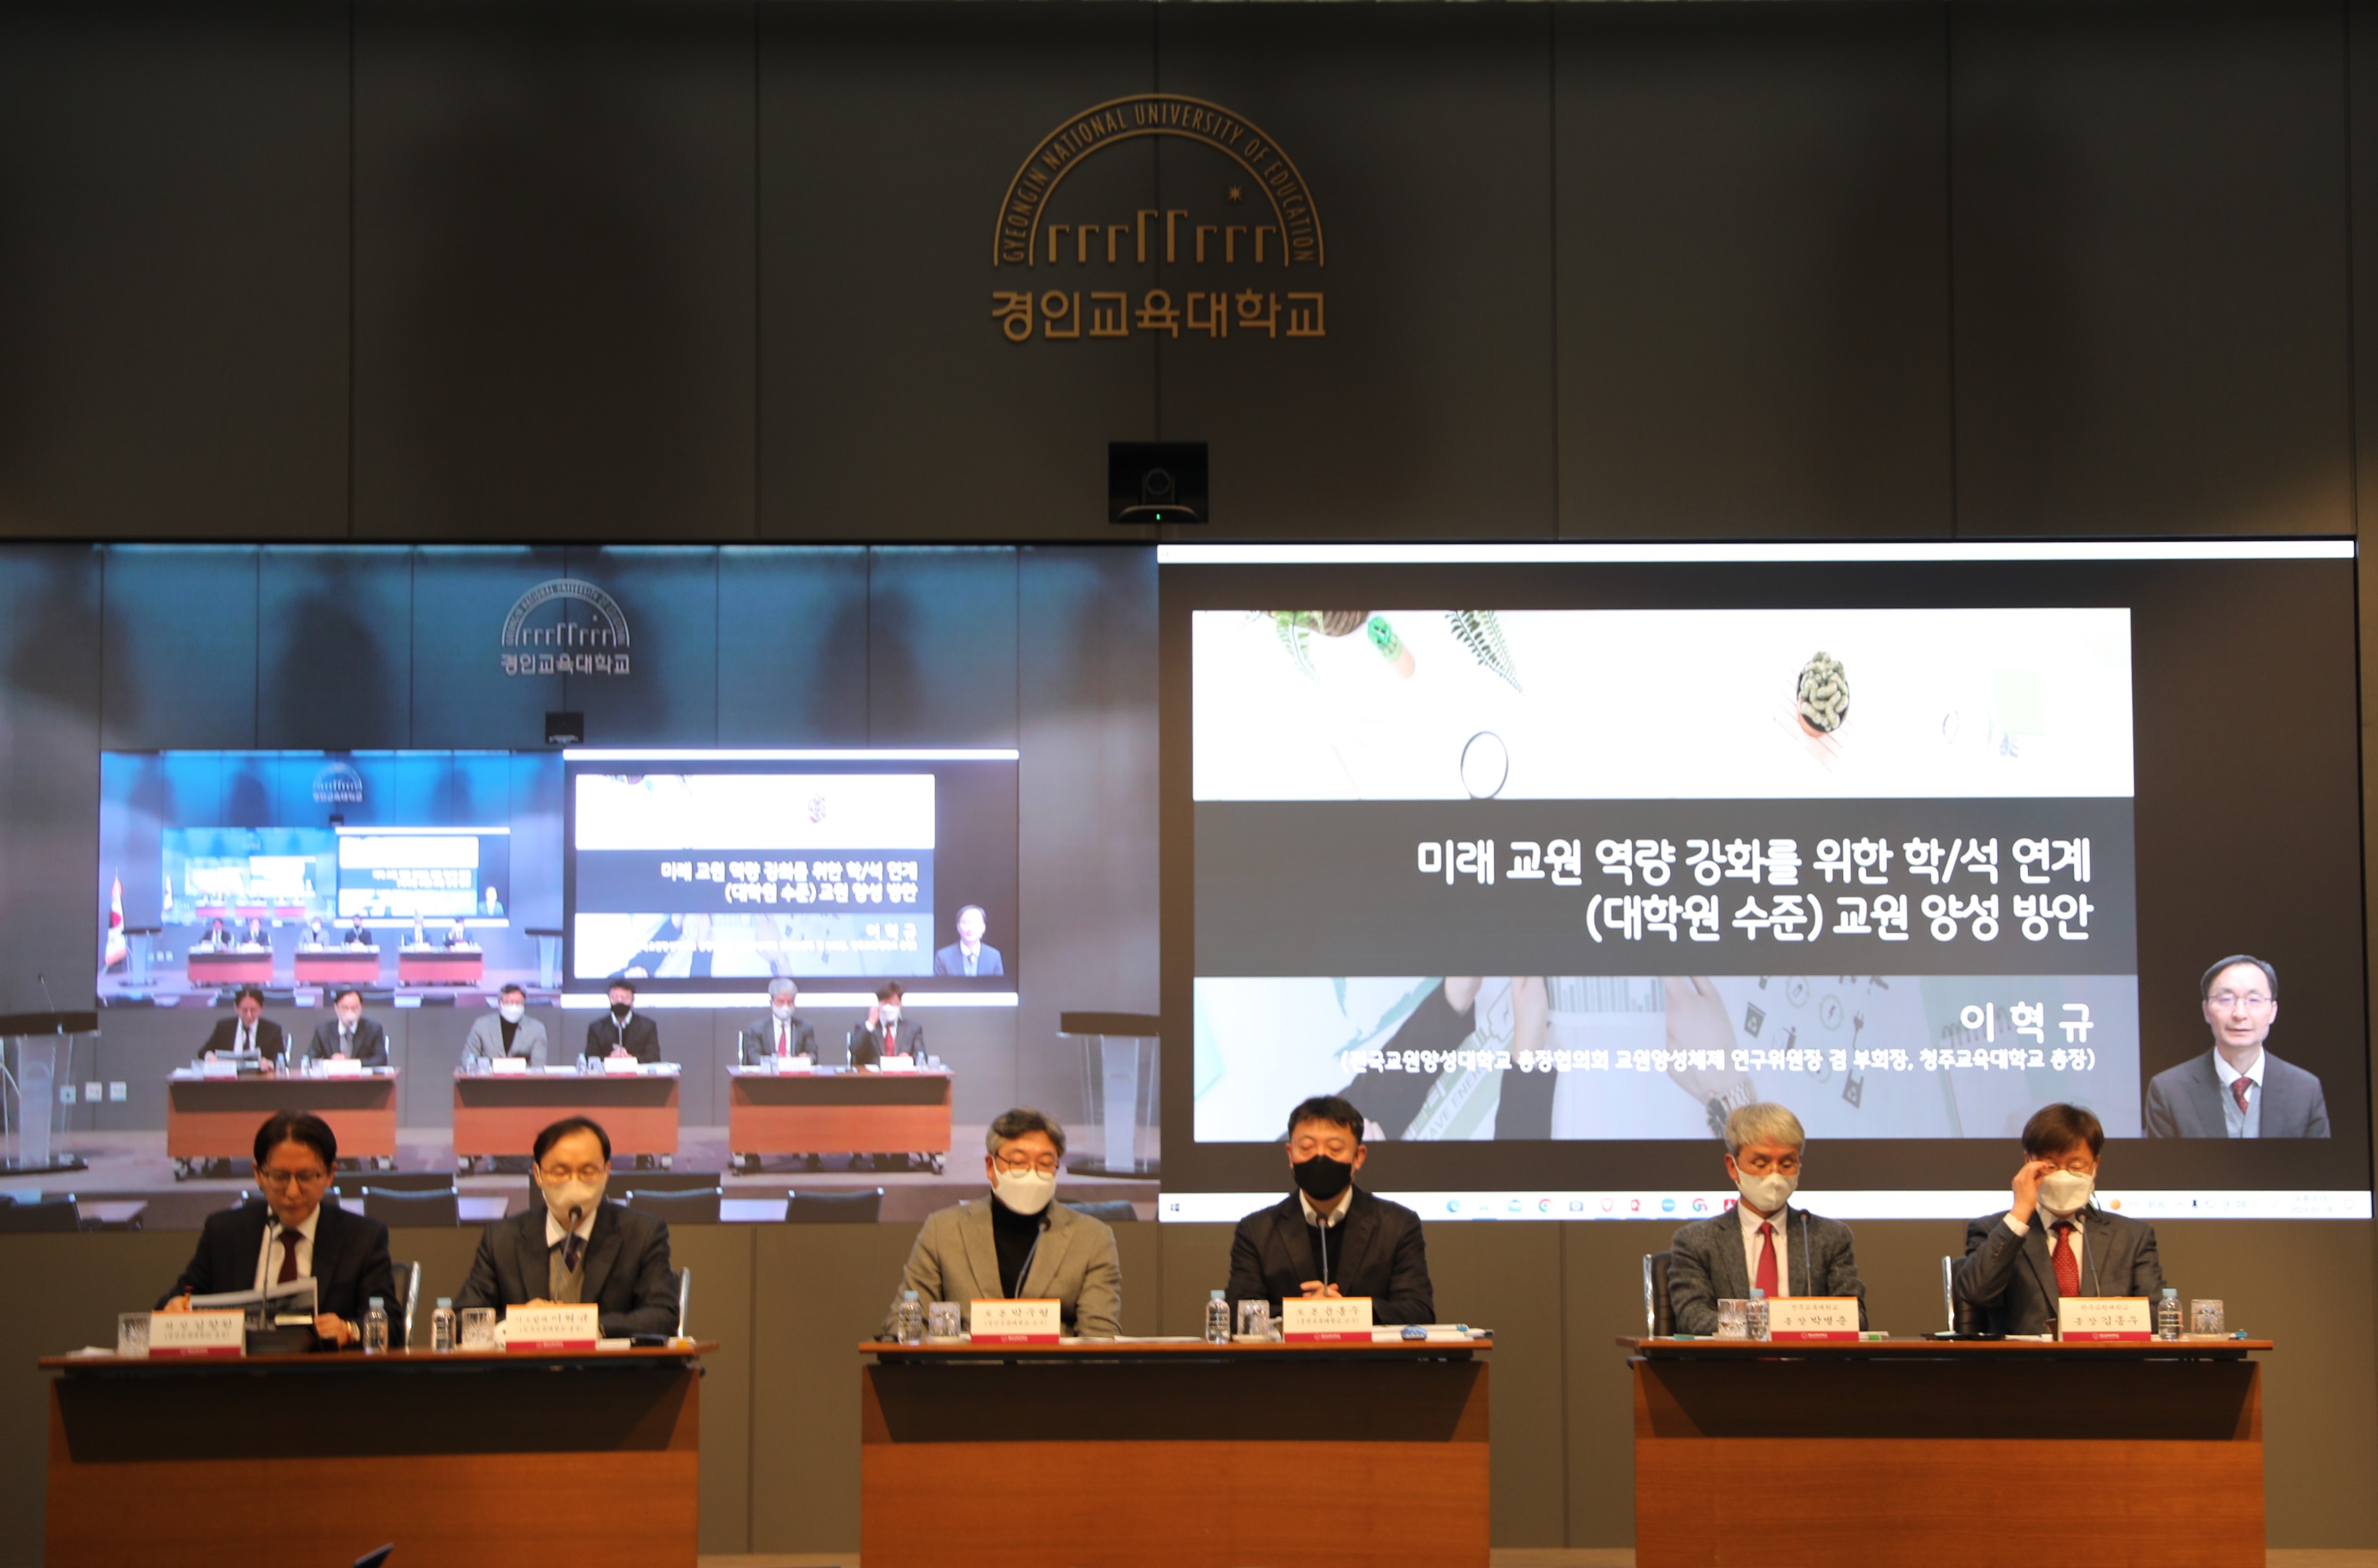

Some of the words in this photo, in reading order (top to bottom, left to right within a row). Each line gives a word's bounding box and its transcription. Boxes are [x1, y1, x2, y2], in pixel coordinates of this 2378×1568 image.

[1003, 167, 1049, 262] GYEONGIN
[1042, 108, 1127, 170] NATIONAL
[1135, 102, 1244, 145] UNIVERSITY
[1244, 138, 1269, 163] OF
[1264, 161, 1315, 261] EDUCATION
[992, 288, 1326, 342] 경인교육대학교
[502, 652, 630, 676] 경인교육대학교
[1417, 839, 1494, 885] 미래
[1506, 839, 1582, 886] 교원
[1595, 839, 1677, 886] 역량
[1685, 838, 1803, 886] 강화를
[1813, 837, 1894, 885] 위한
[1902, 837, 1998, 885] 학/석
[2012, 838, 2091, 884] 연계
[1586, 894, 1720, 943] (대학원
[1732, 894, 1823, 943] 수준)
[1833, 894, 1909, 941] 교원
[1921, 894, 1999, 941] 양성
[2013, 894, 2094, 941] 방안
[1960, 1002, 1994, 1043] 이
[2010, 1001, 2044, 1043] 혁
[2058, 1003, 2094, 1043] 규
[1340, 1049, 1512, 1073] (전국교원양성대학교
[1517, 1049, 1609, 1073] 총장협의회
[1615, 1049, 1725, 1072] 교원양성체제
[1731, 1049, 1823, 1071] 연구위원장
[1829, 1049, 1847, 1071] 겸
[1853, 1049, 1914, 1071] 부회장,
[1920, 1049, 2045, 1071] 청주교육대학교
[2050, 1048, 2096, 1071] 총장)
